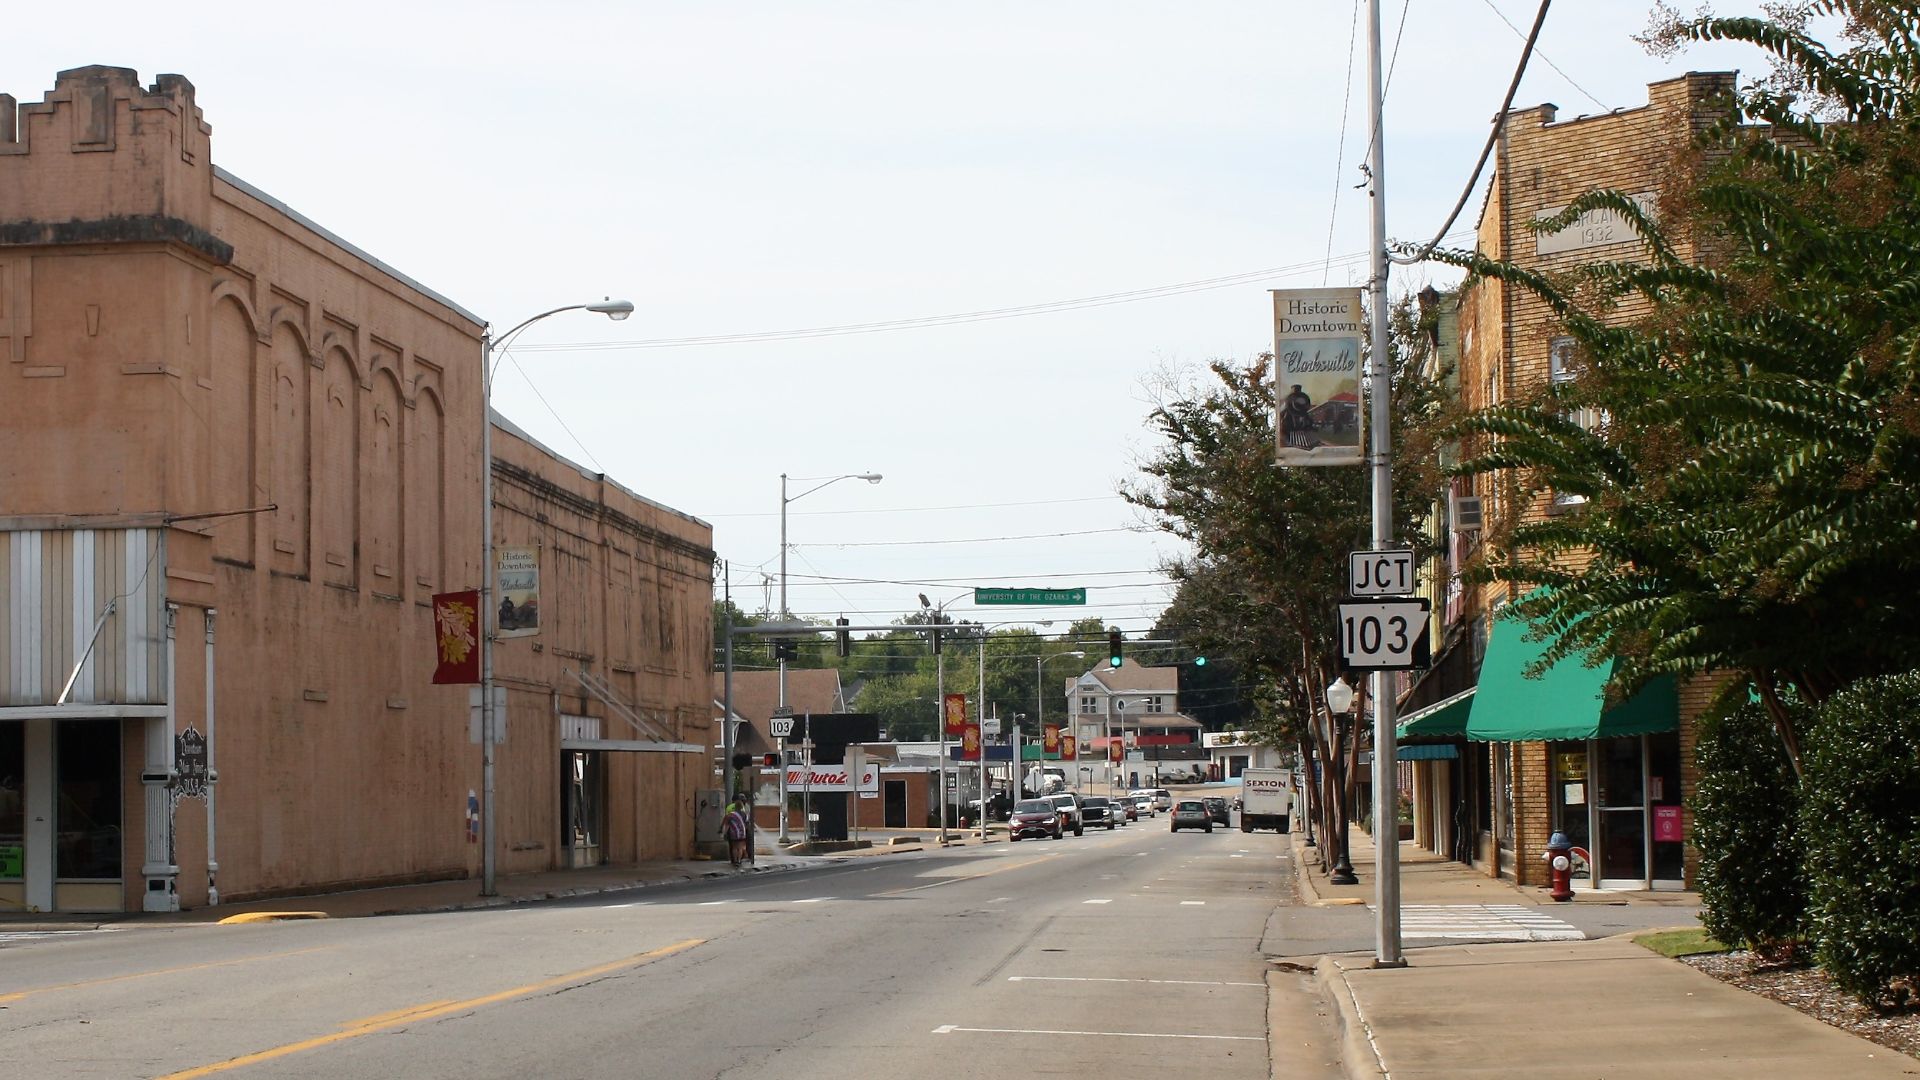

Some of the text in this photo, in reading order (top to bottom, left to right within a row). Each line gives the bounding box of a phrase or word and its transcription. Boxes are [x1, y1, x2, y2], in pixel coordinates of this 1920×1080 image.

[1581, 225, 1613, 244] 1932
[1288, 299, 1348, 315] Historic
[1279, 318, 1357, 334] Downtown
[1283, 349, 1356, 373] Clarksville
[502, 551, 532, 560] Historic
[497, 561, 537, 570] Downtown
[1355, 558, 1409, 588] JCT
[1345, 615, 1408, 654] 103
[773, 721, 790, 733] 103
[808, 771, 872, 784] AutoZe
[1246, 779, 1286, 788] SEXTON
